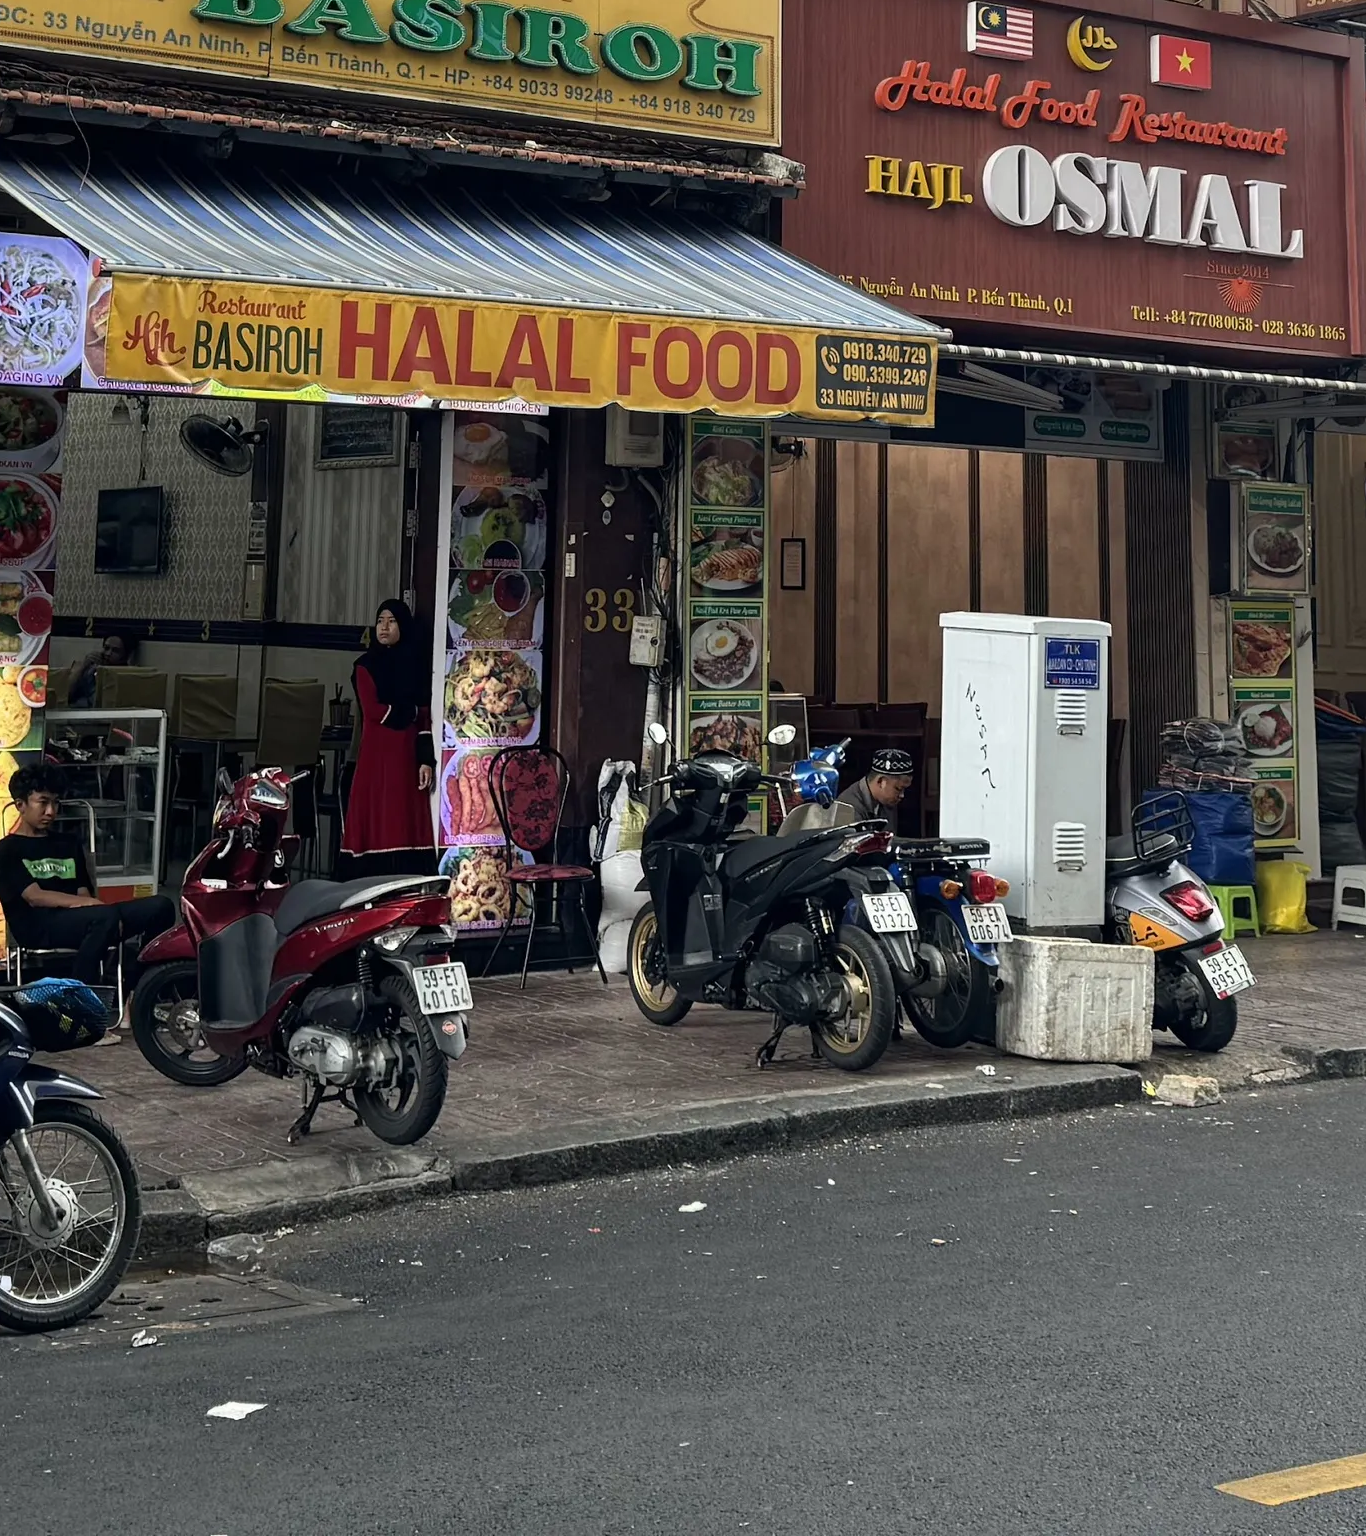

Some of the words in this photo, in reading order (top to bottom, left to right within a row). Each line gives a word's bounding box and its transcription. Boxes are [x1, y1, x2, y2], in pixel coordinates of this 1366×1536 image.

[874, 59, 1001, 112] Halal
[1001, 79, 1103, 130] Food
[1108, 92, 1289, 156] Restaurant
[864, 154, 974, 210] HAJI.
[982, 144, 1304, 260] OSMAL
[1206, 259, 1239, 276] Since
[1242, 264, 1270, 279] 2014
[198, 288, 307, 322] Restaurant
[1131, 305, 1160, 322] Tell:
[1163, 310, 1187, 326] +84
[1262, 319, 1284, 335] 028
[1287, 321, 1315, 338] 3636
[1319, 324, 1346, 341] 1865
[122, 310, 186, 367] Hjh.
[192, 319, 323, 377] BASIROH
[337, 298, 591, 395] HALAL
[616, 320, 802, 407] FOOD
[842, 341, 927, 364] 0918.340.729
[47, 372, 64, 386] VN
[843, 367, 927, 386] 090.3399.248
[820, 388, 833, 405] 33
[837, 385, 879, 409] NGUYỄN
[882, 393, 898, 409] AN
[900, 393, 925, 410] NINH
[584, 587, 634, 633] 33
[1064, 644, 1080, 654] TLK
[871, 897, 903, 912] 59-E1
[874, 912, 914, 929] 913.22
[969, 908, 1001, 926] 59-EA
[1207, 952, 1239, 974] 59-E1
[422, 966, 458, 990] 59-E1
[1212, 964, 1249, 991] 995.17
[423, 986, 470, 1011] 401.64
